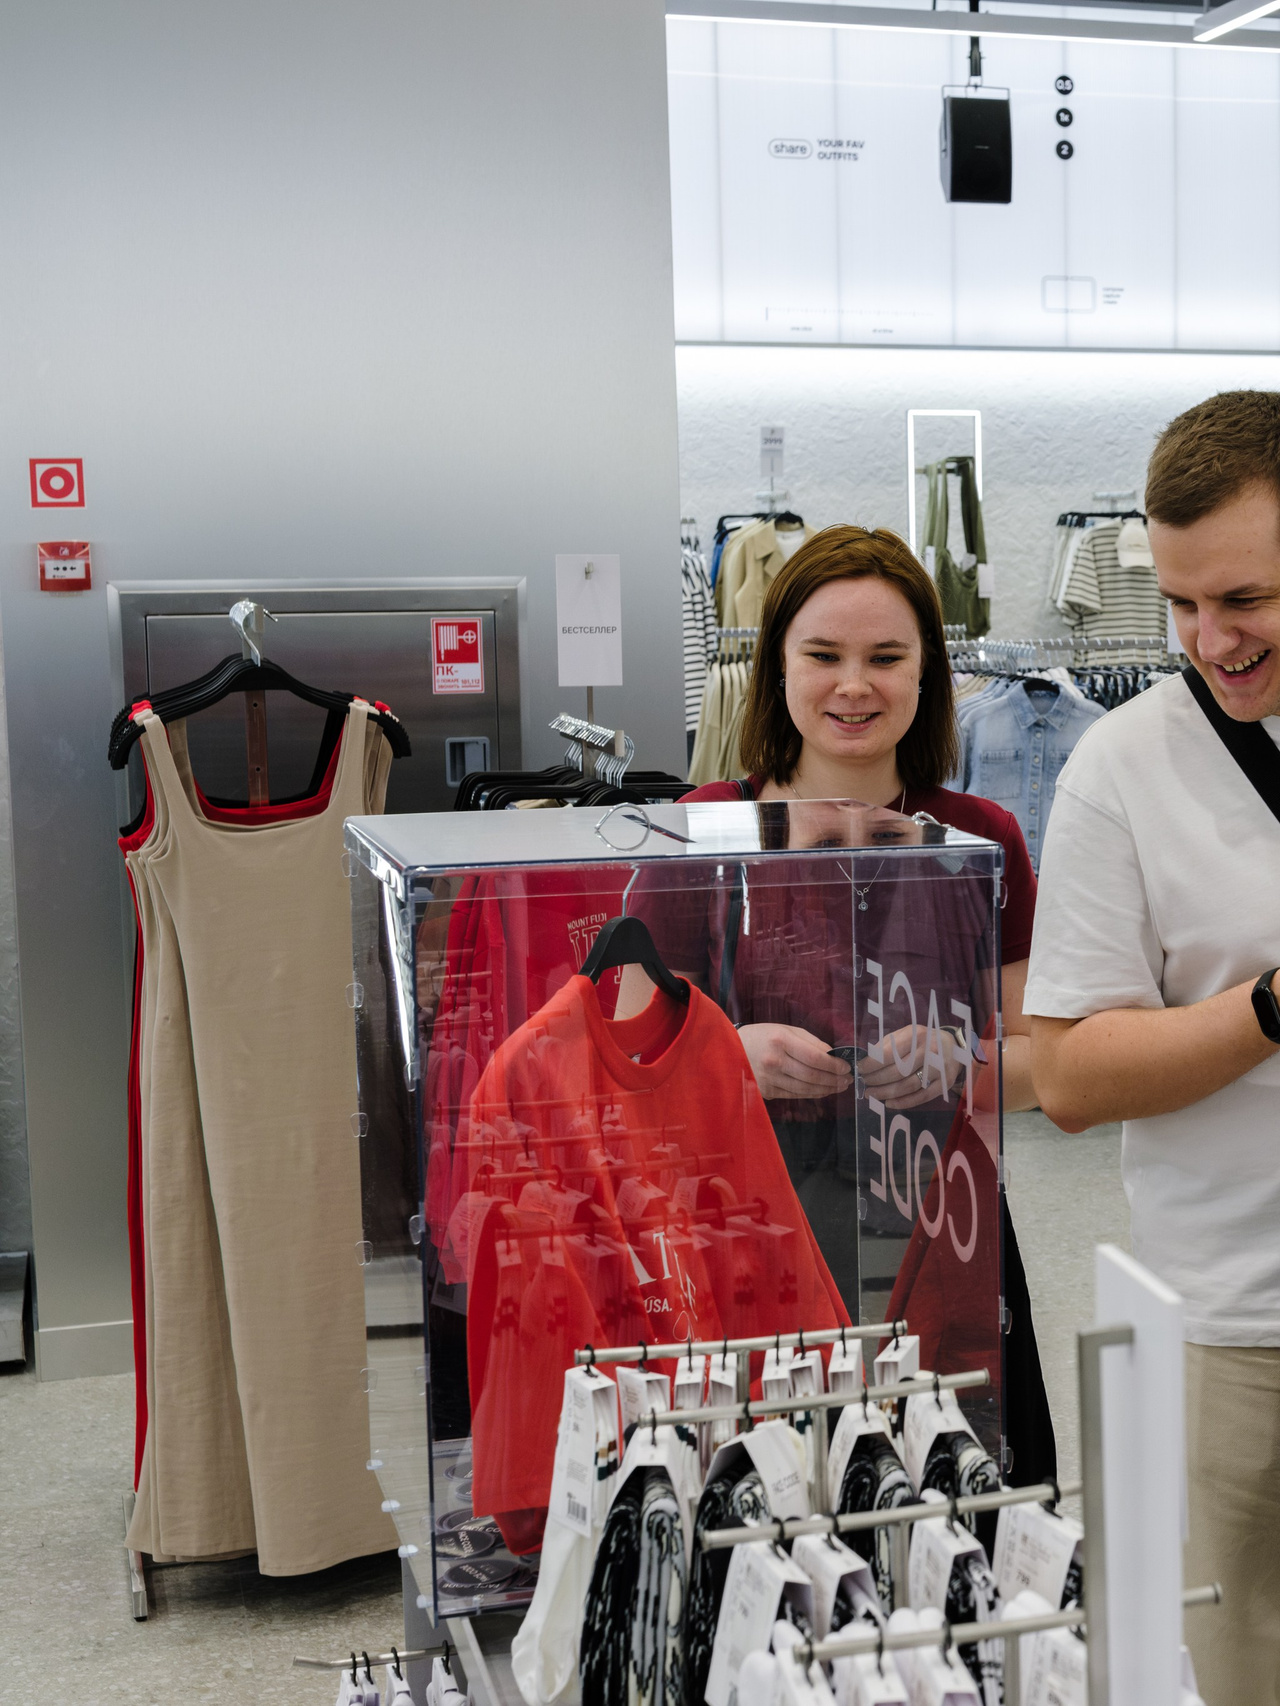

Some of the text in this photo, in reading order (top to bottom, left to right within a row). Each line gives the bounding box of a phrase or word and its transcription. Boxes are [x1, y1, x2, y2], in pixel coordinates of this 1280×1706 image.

[774, 142, 807, 155] share
[818, 140, 865, 149] YOUR FAV
[1061, 144, 1069, 155] 2
[817, 151, 859, 161] OUTFITS
[562, 626, 617, 634] БЕСТСЕЛЛЕР
[567, 912, 607, 931] MOUNT FUJI
[644, 1297, 673, 1313] USA.
